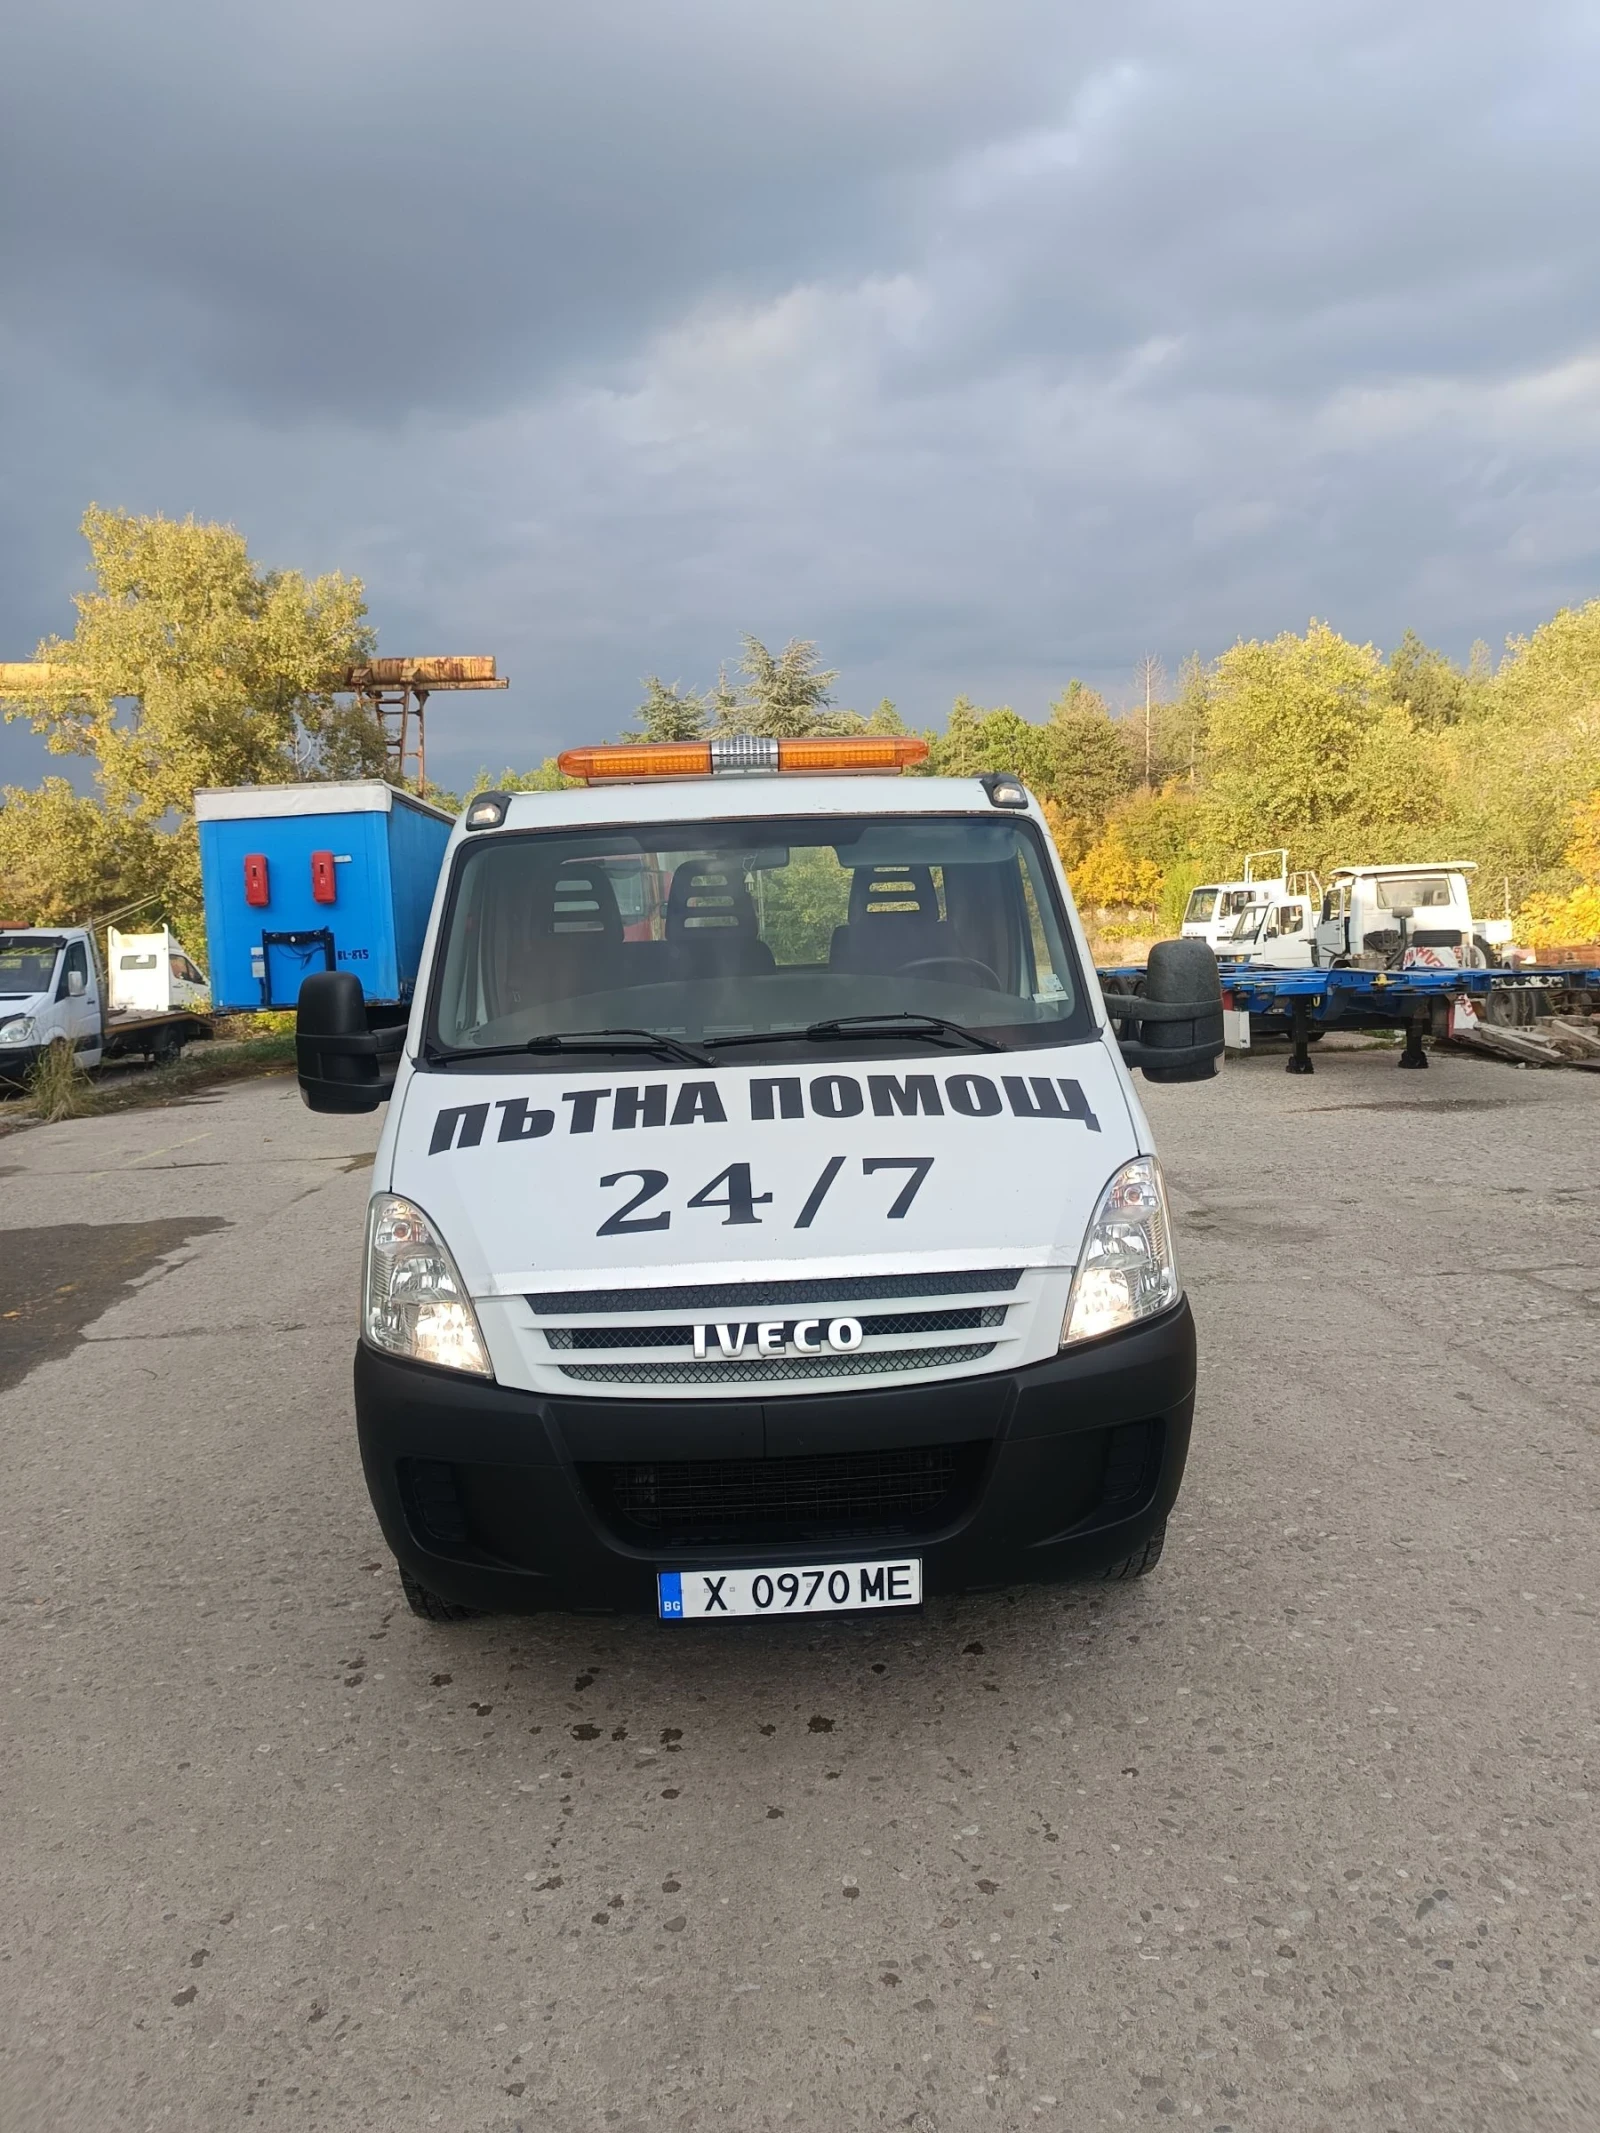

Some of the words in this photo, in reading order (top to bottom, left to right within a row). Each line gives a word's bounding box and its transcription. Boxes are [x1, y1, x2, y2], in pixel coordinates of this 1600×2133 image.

[428, 1081, 728, 1156] ПЪТНА
[749, 1073, 1102, 1133] ПОМОЩ
[595, 1155, 935, 1237] 24/7
[693, 1317, 864, 1358] IVECO
[663, 1600, 681, 1612] BG
[703, 1576, 728, 1612] X
[751, 1569, 850, 1609] 0970
[860, 1565, 912, 1603] ME
